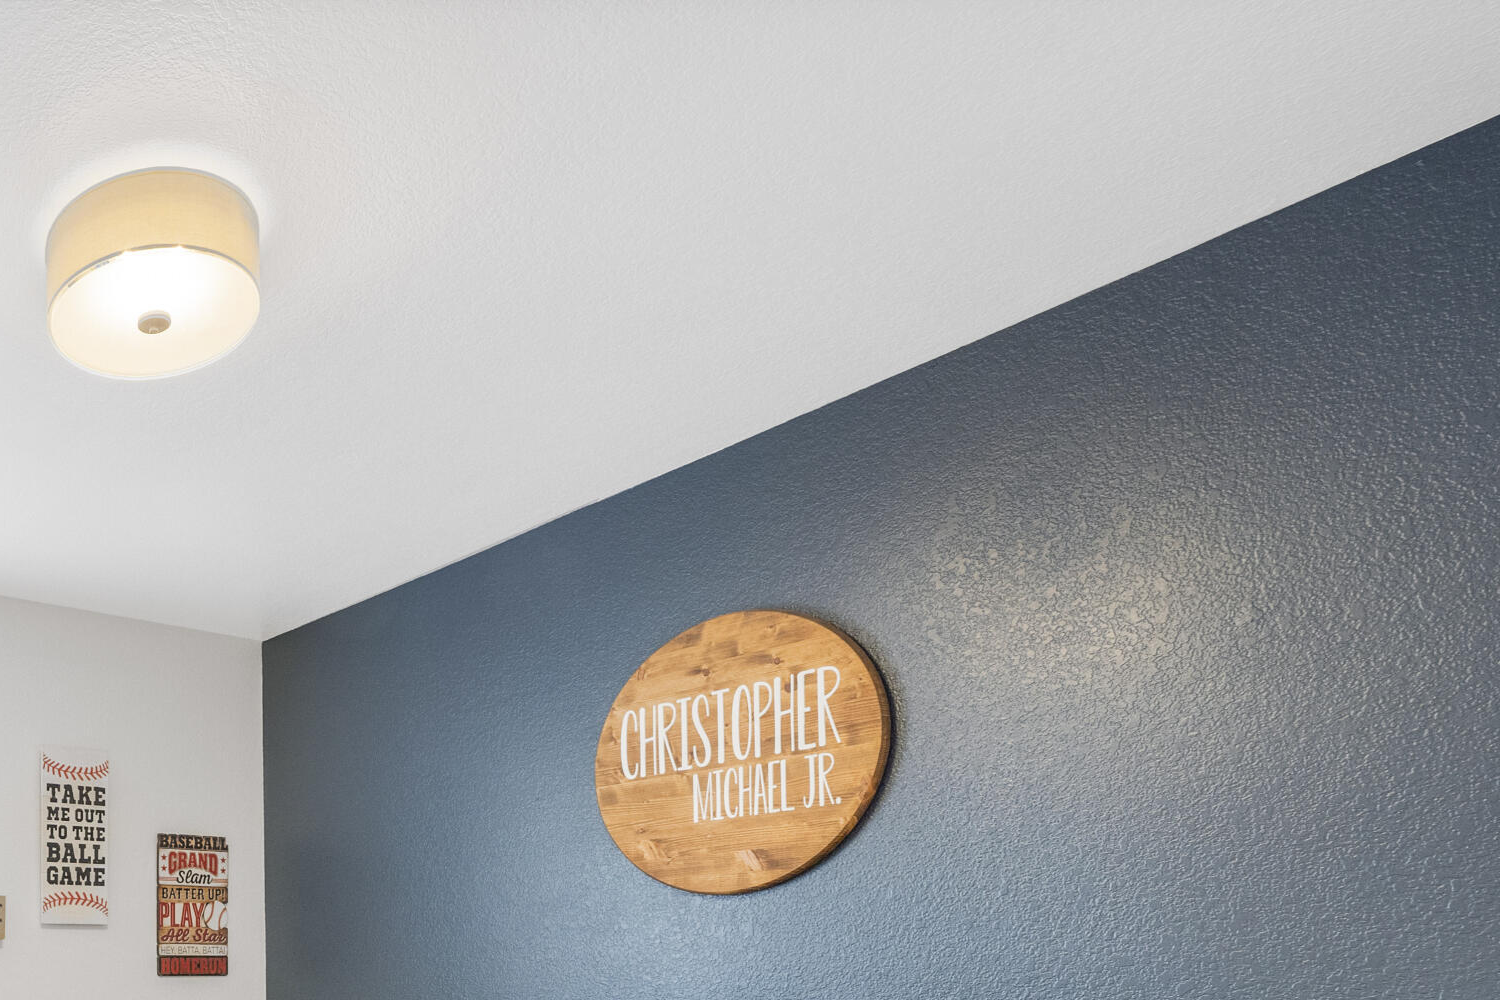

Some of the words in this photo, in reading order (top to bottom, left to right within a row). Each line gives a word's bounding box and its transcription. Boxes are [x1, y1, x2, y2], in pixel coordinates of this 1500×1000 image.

[620, 665, 841, 780] CHRISTOPHER
[46, 783, 106, 806] TAKE
[692, 759, 795, 824] MICHAEL
[803, 753, 842, 808] JR.
[47, 806, 70, 822] ME
[75, 808, 106, 823] OUT
[46, 824, 67, 840] TO
[72, 825, 106, 841] THE
[159, 834, 228, 851] BASEBALL
[46, 842, 106, 864] BALL
[168, 851, 219, 877] GRAND
[46, 865, 106, 886] GAME
[176, 869, 212, 884] Slam
[161, 887, 204, 900] BATTER
[208, 888, 225, 900] UP!
[159, 901, 205, 928] PLAY
[161, 928, 190, 942] All
